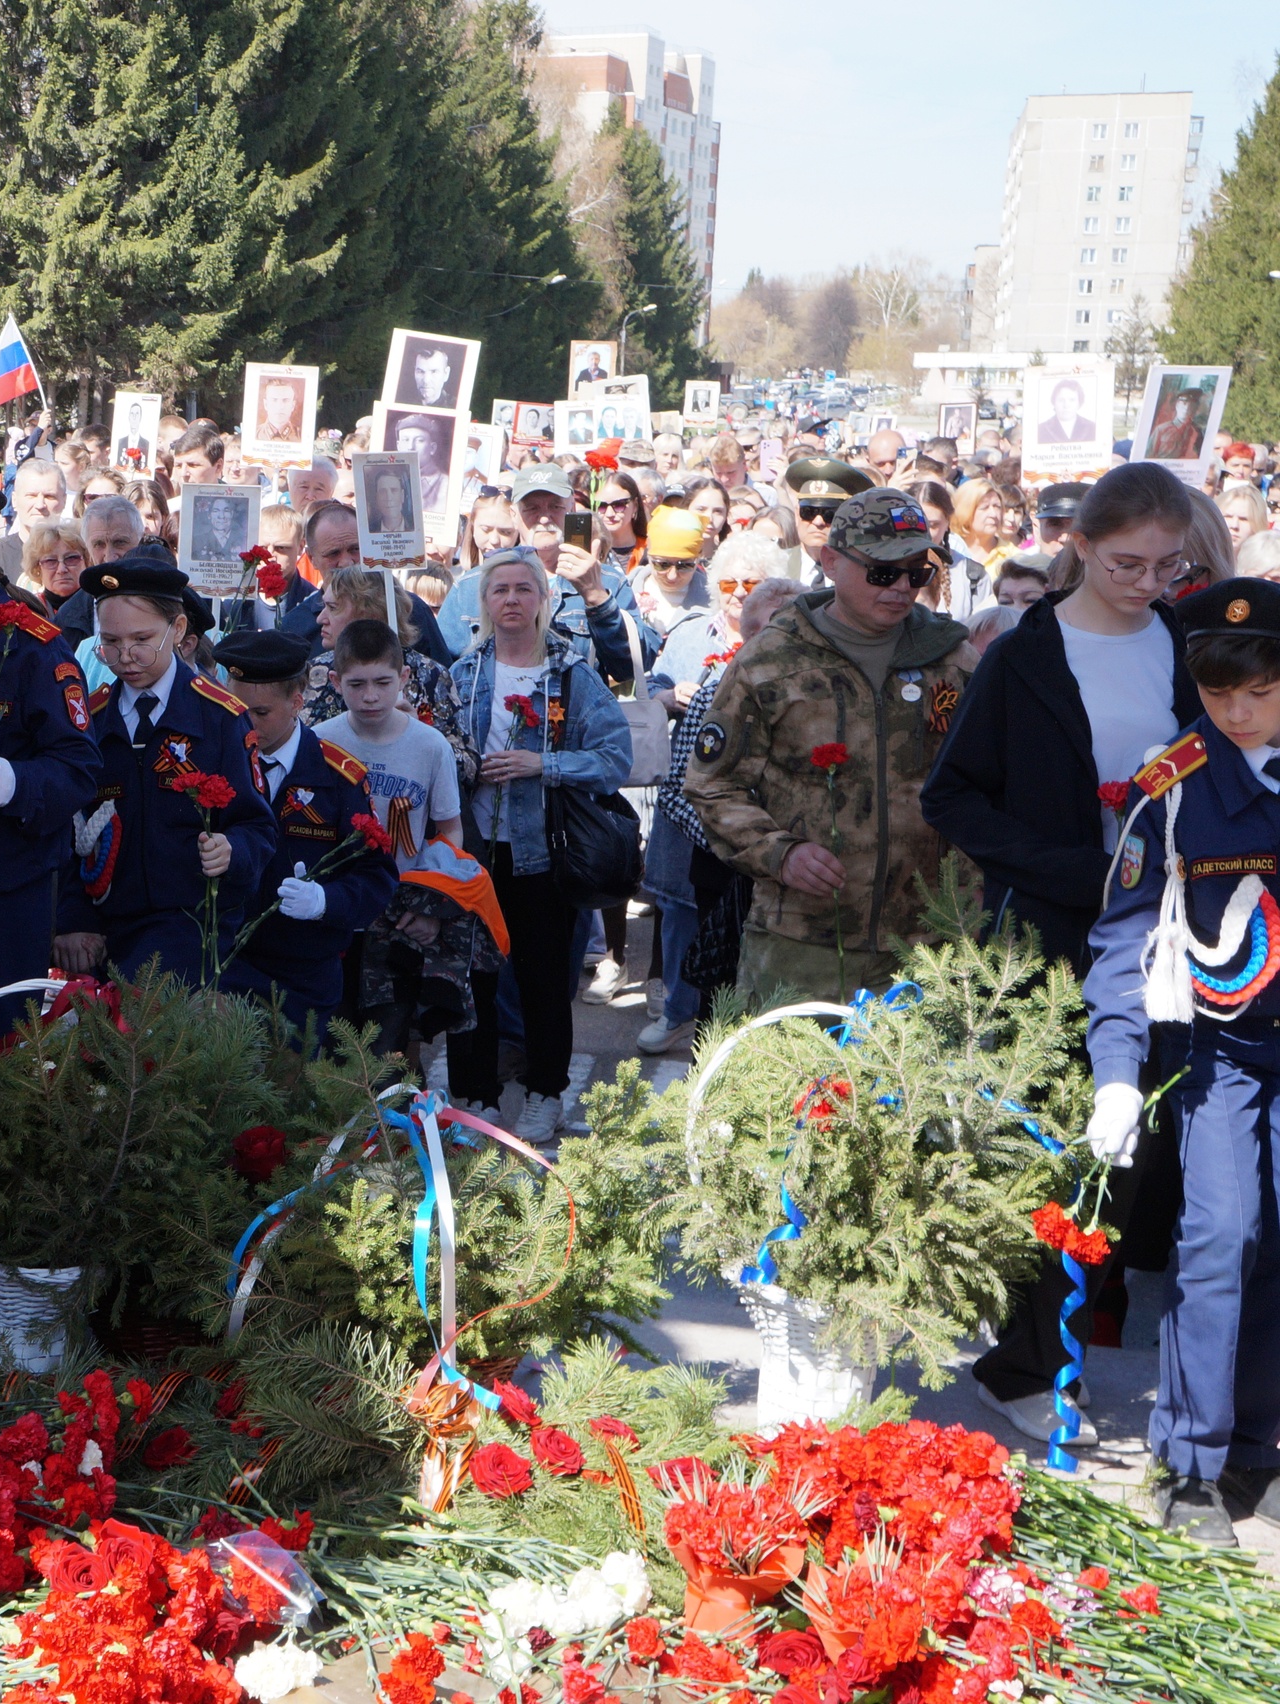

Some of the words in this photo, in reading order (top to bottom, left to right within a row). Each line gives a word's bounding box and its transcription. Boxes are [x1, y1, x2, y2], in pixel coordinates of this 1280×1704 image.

[35, 623, 51, 635] КК
[1145, 766, 1168, 790] КК
[1193, 859, 1242, 875] КАДЕТСКИЙ
[1244, 859, 1273, 870] КЛАСС
